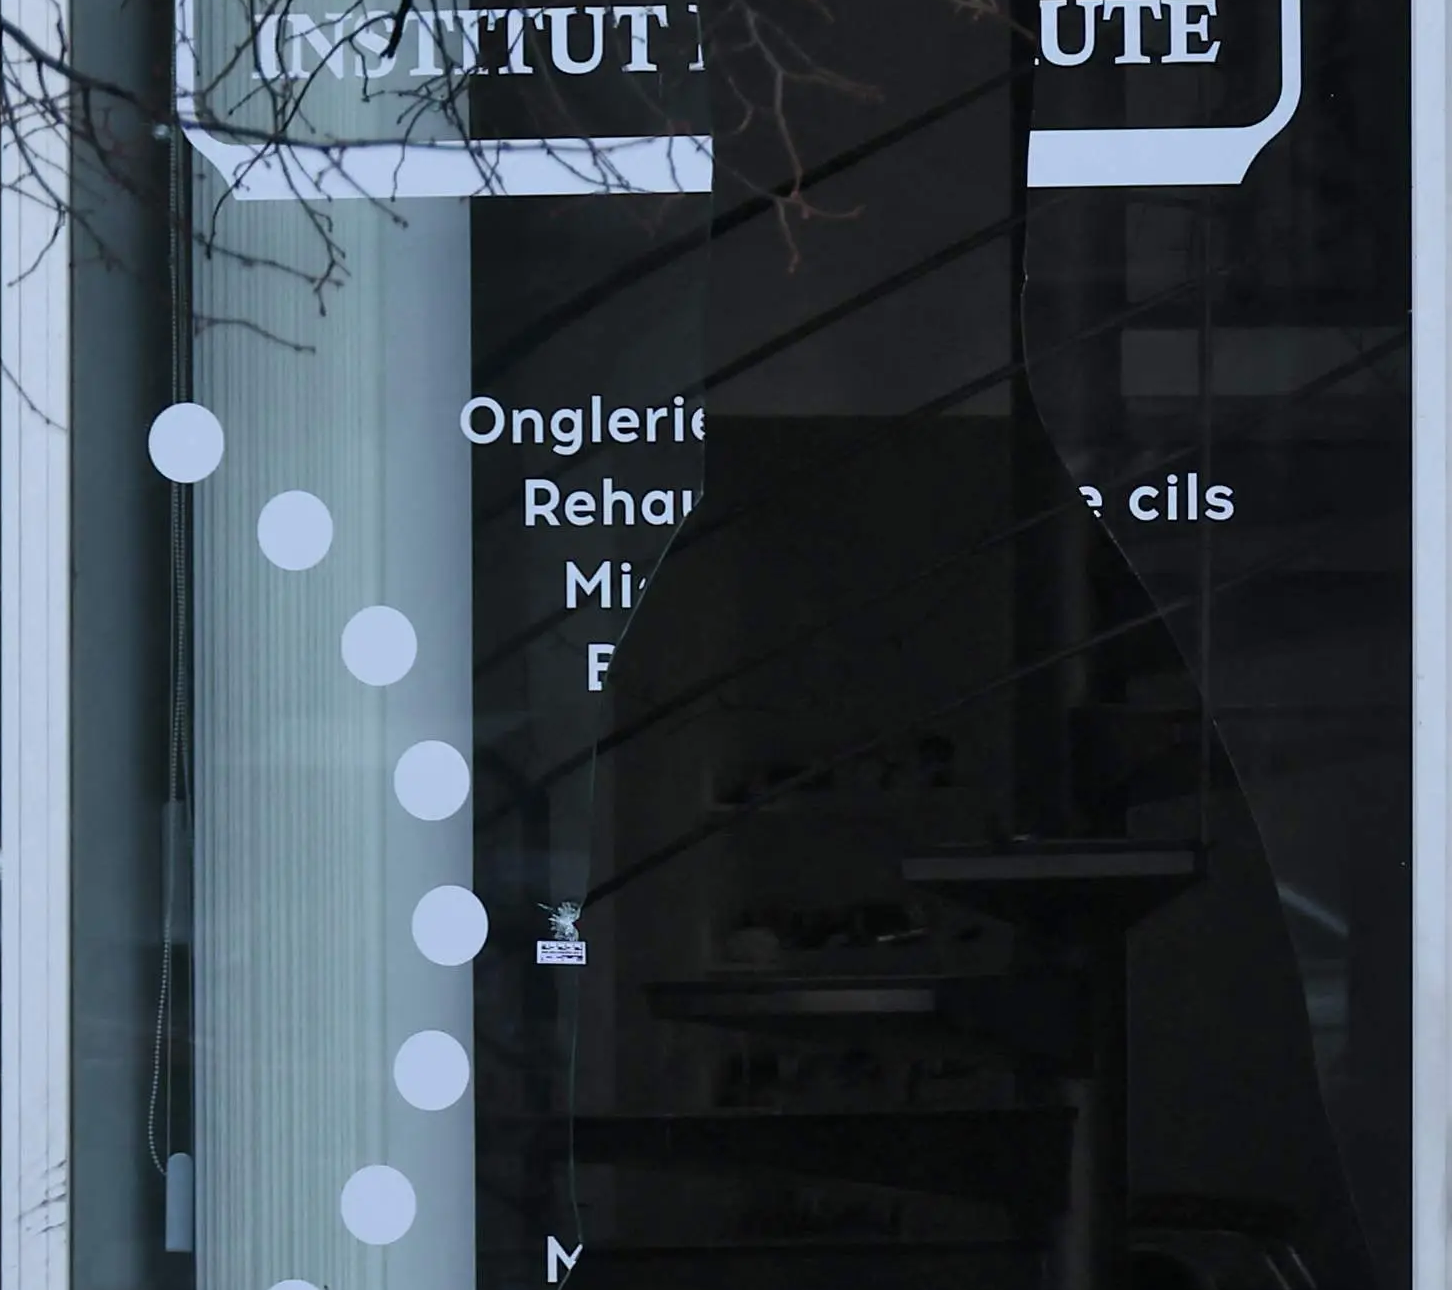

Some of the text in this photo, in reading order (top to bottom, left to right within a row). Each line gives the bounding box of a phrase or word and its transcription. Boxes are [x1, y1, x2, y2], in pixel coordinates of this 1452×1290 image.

[252, 3, 668, 80] INSTITUT
[1128, 472, 1235, 521] cils
[565, 560, 647, 609] Mi
